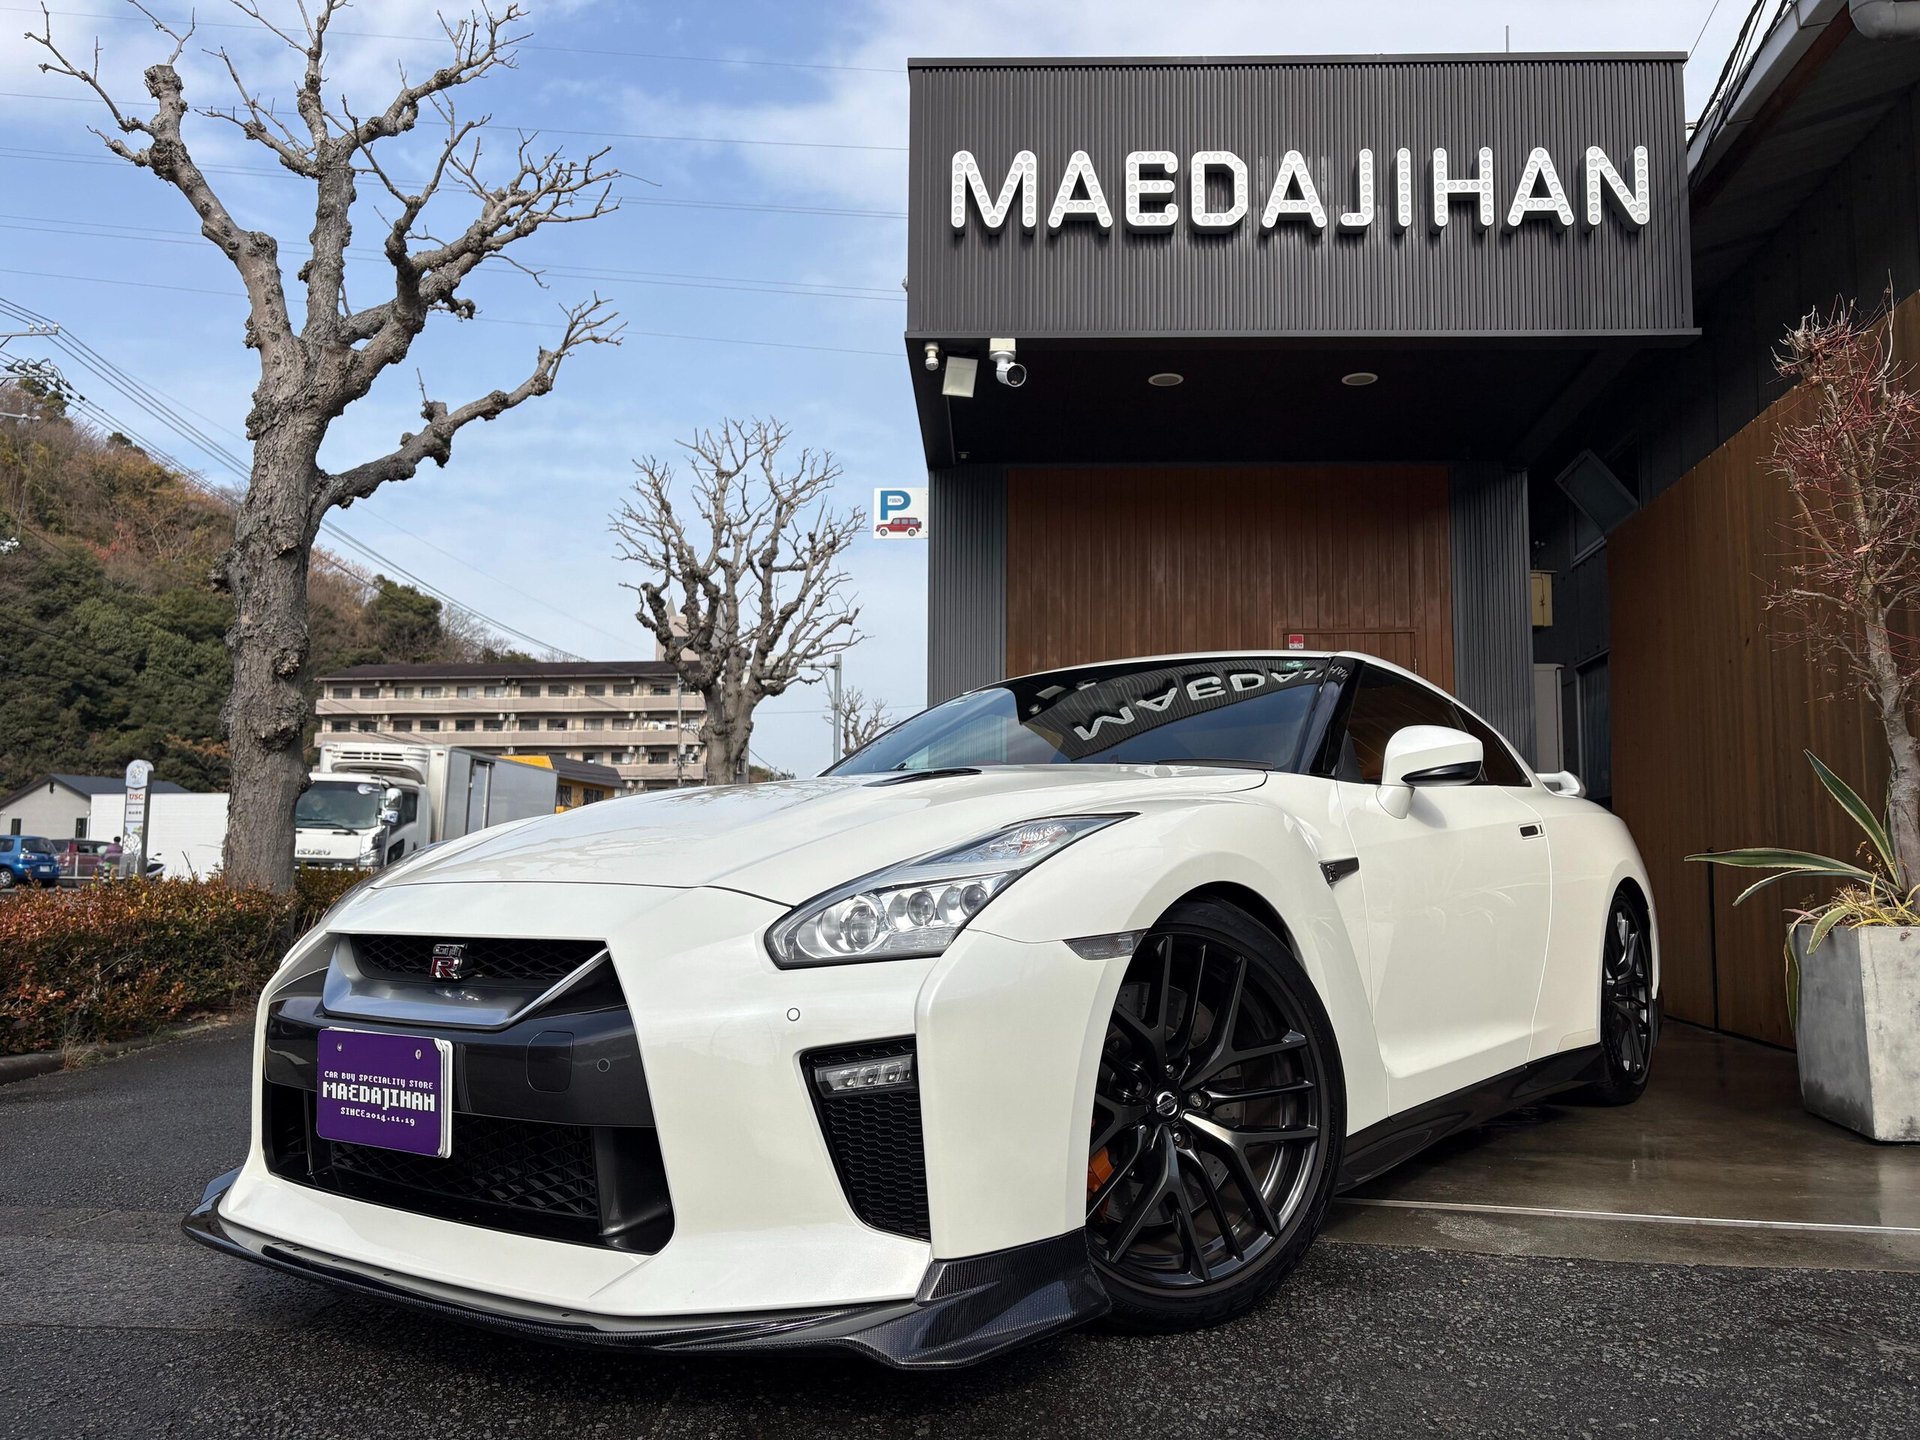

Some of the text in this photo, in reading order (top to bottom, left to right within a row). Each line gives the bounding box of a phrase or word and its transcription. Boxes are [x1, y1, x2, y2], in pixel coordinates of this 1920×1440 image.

[950, 145, 1649, 235] MAEDAJIHAN
[880, 490, 911, 520] P
[324, 1070, 434, 1090] CAR BUY SPECIALITY STORE
[322, 1081, 435, 1112] MAEDAJIHAN
